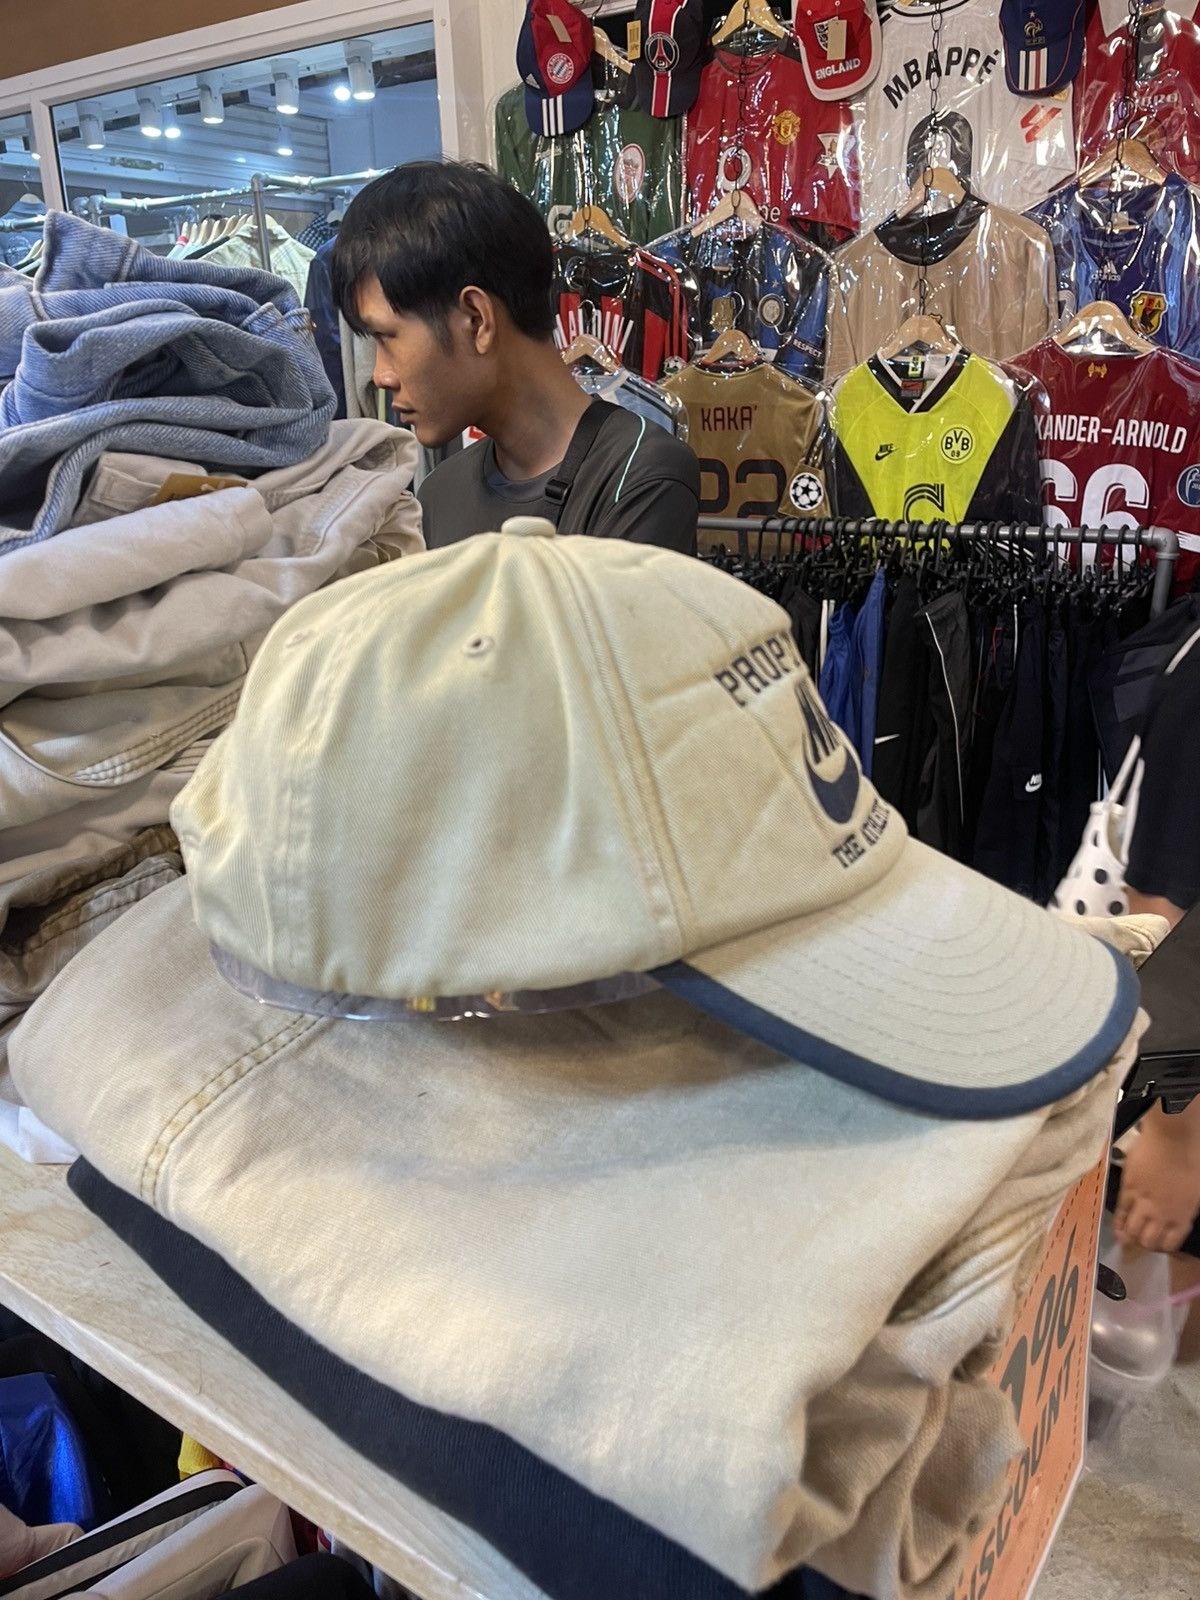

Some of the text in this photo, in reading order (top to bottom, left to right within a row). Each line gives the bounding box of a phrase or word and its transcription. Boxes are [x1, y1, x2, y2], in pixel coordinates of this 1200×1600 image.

[815, 57, 861, 80] ENGLAND
[883, 46, 1000, 109] MBAPPÉ
[945, 430, 970, 451] BVB
[832, 832, 866, 869] THE
